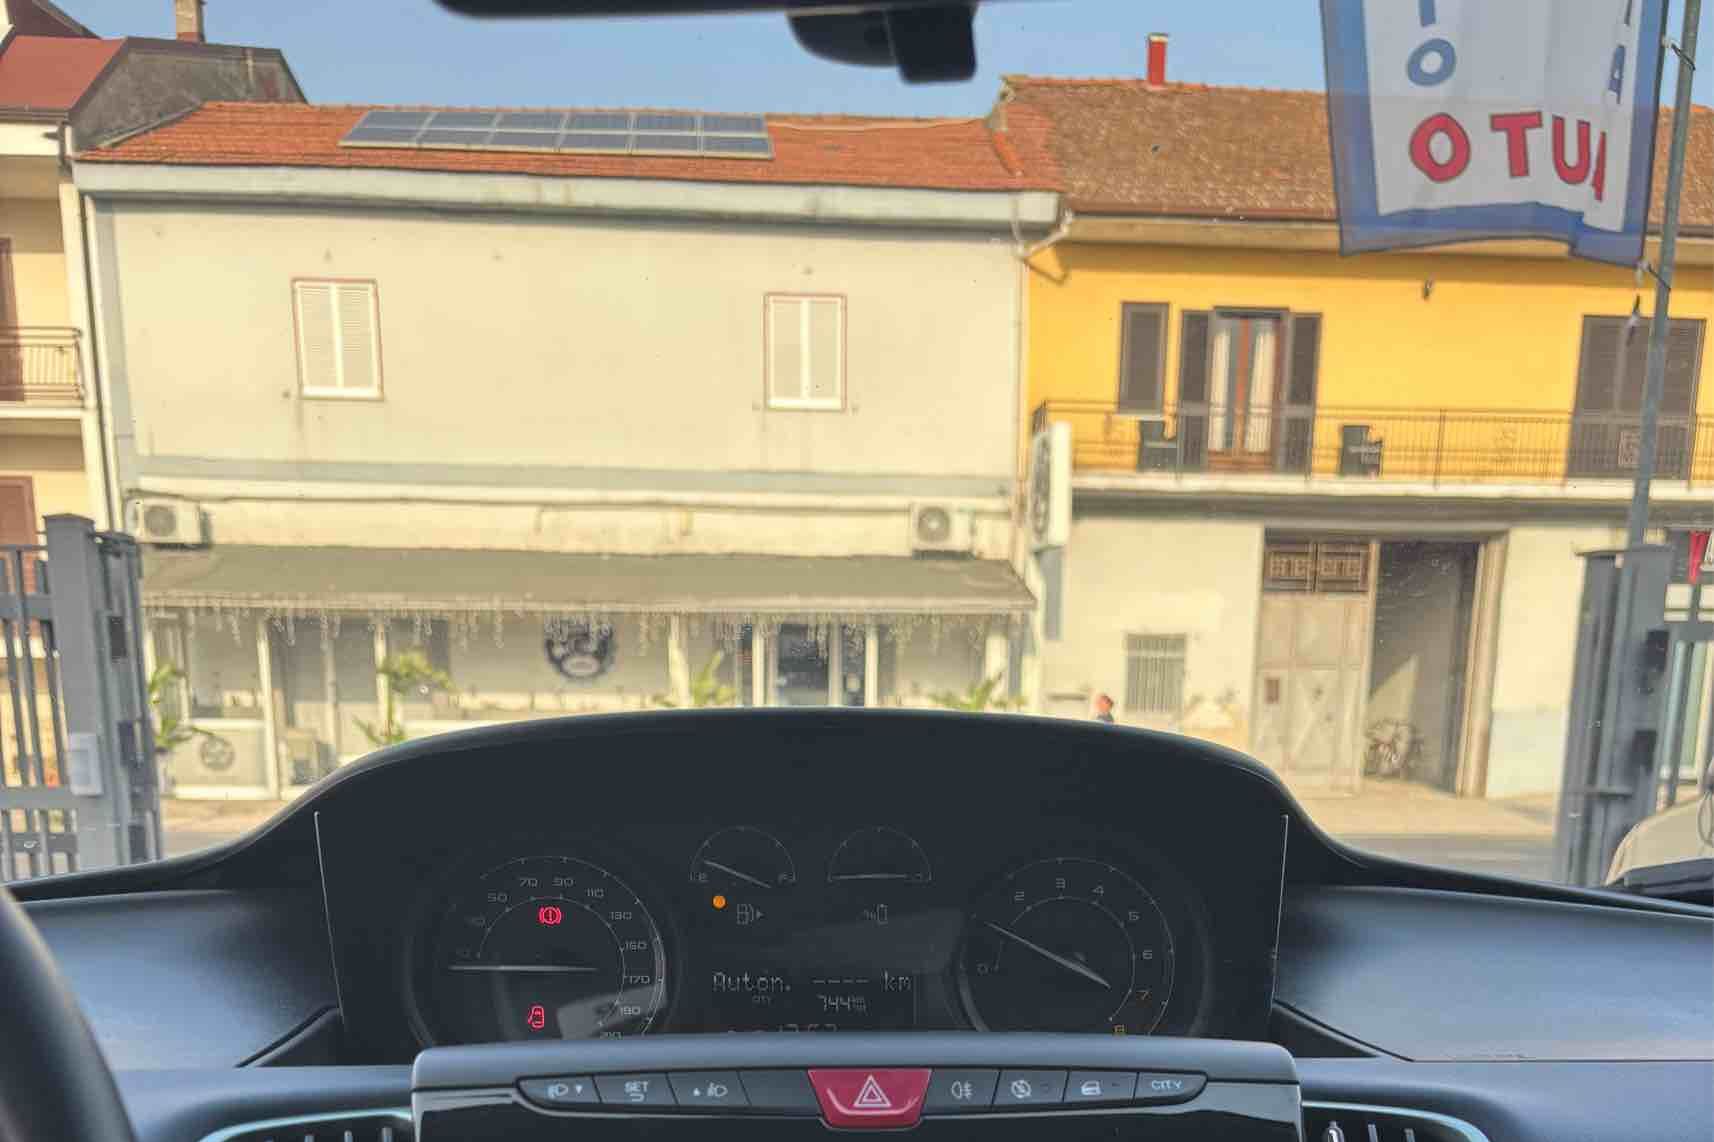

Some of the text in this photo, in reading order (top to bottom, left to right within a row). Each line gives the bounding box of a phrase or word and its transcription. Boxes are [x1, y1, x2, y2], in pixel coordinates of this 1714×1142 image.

[520, 878, 538, 887] 70
[587, 888, 604, 898] 110
[628, 975, 649, 984] 170
[884, 971, 912, 992] km
[625, 1081, 648, 1093] SET
[1151, 1079, 1182, 1091] CITY
